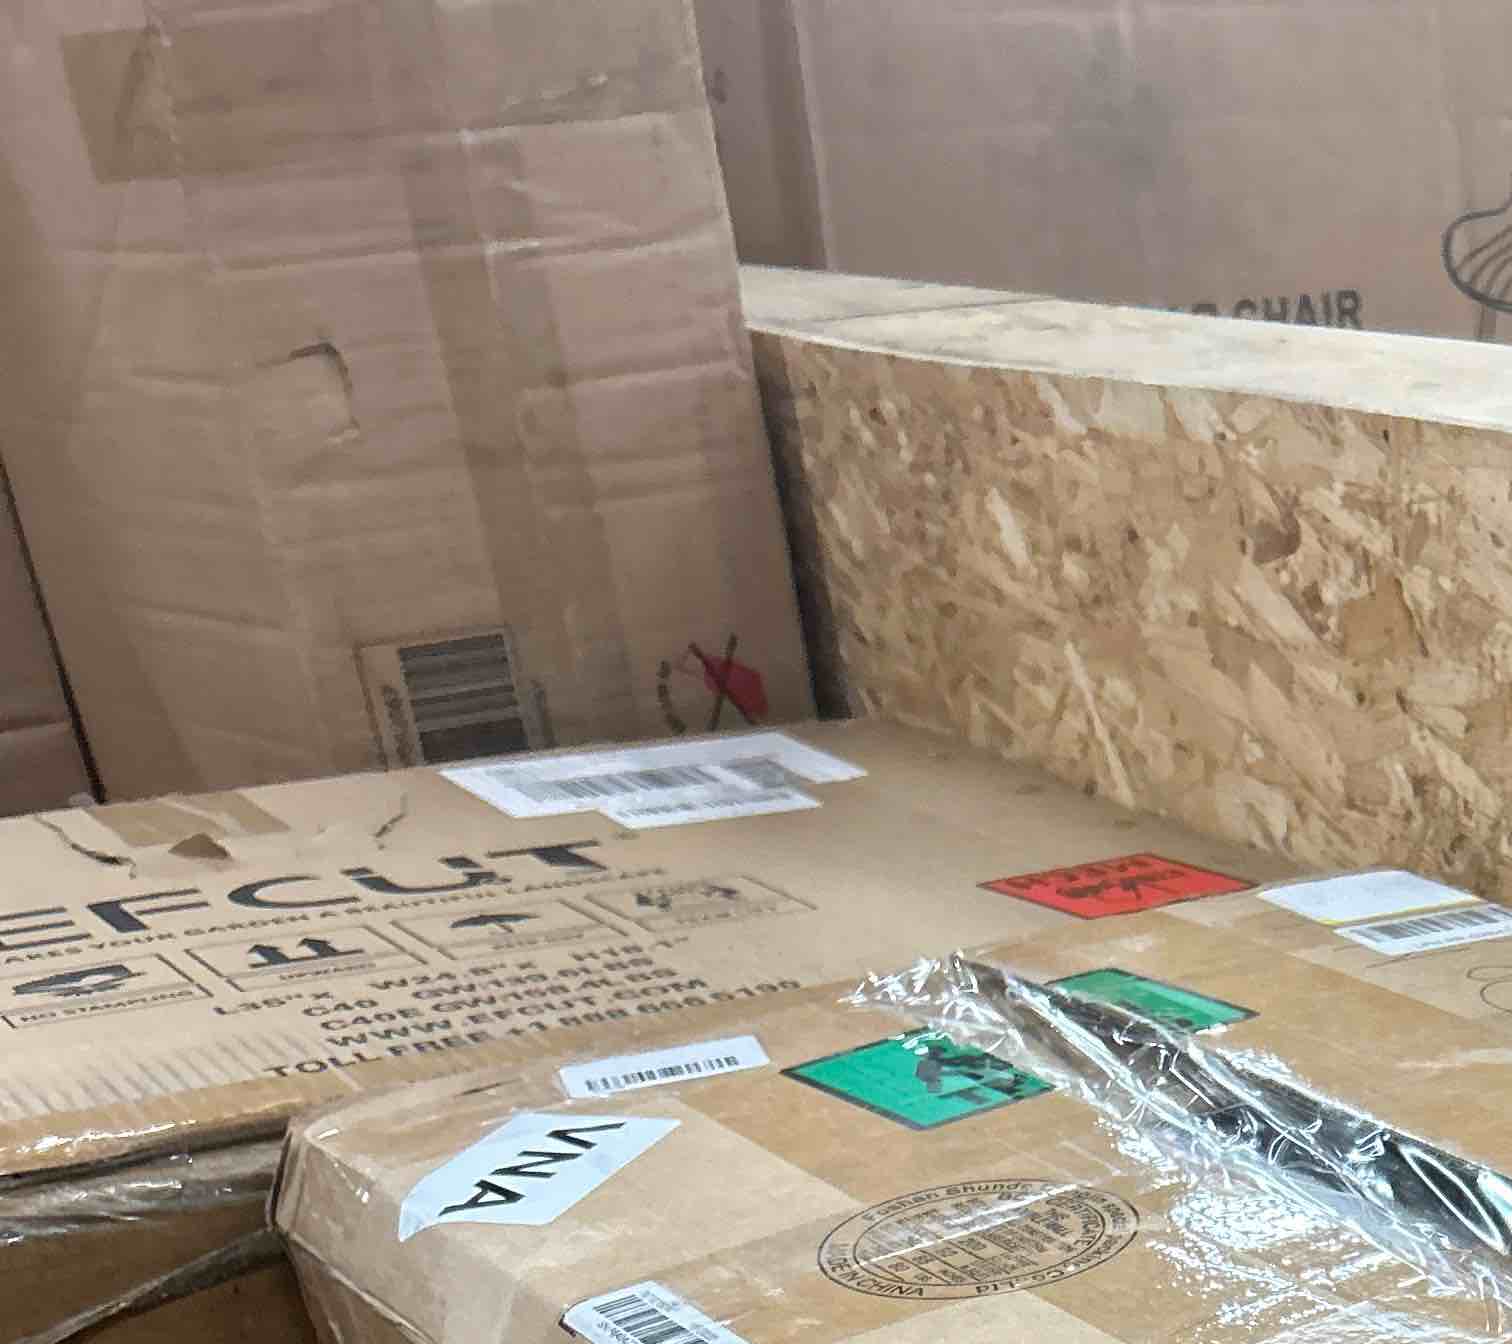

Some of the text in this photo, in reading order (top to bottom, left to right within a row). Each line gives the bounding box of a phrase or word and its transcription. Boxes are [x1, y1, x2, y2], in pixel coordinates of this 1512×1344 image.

[263, 1051, 384, 1078] TOLL
[386, 1029, 494, 1057] FREE
[437, 1120, 626, 1218] VNA
